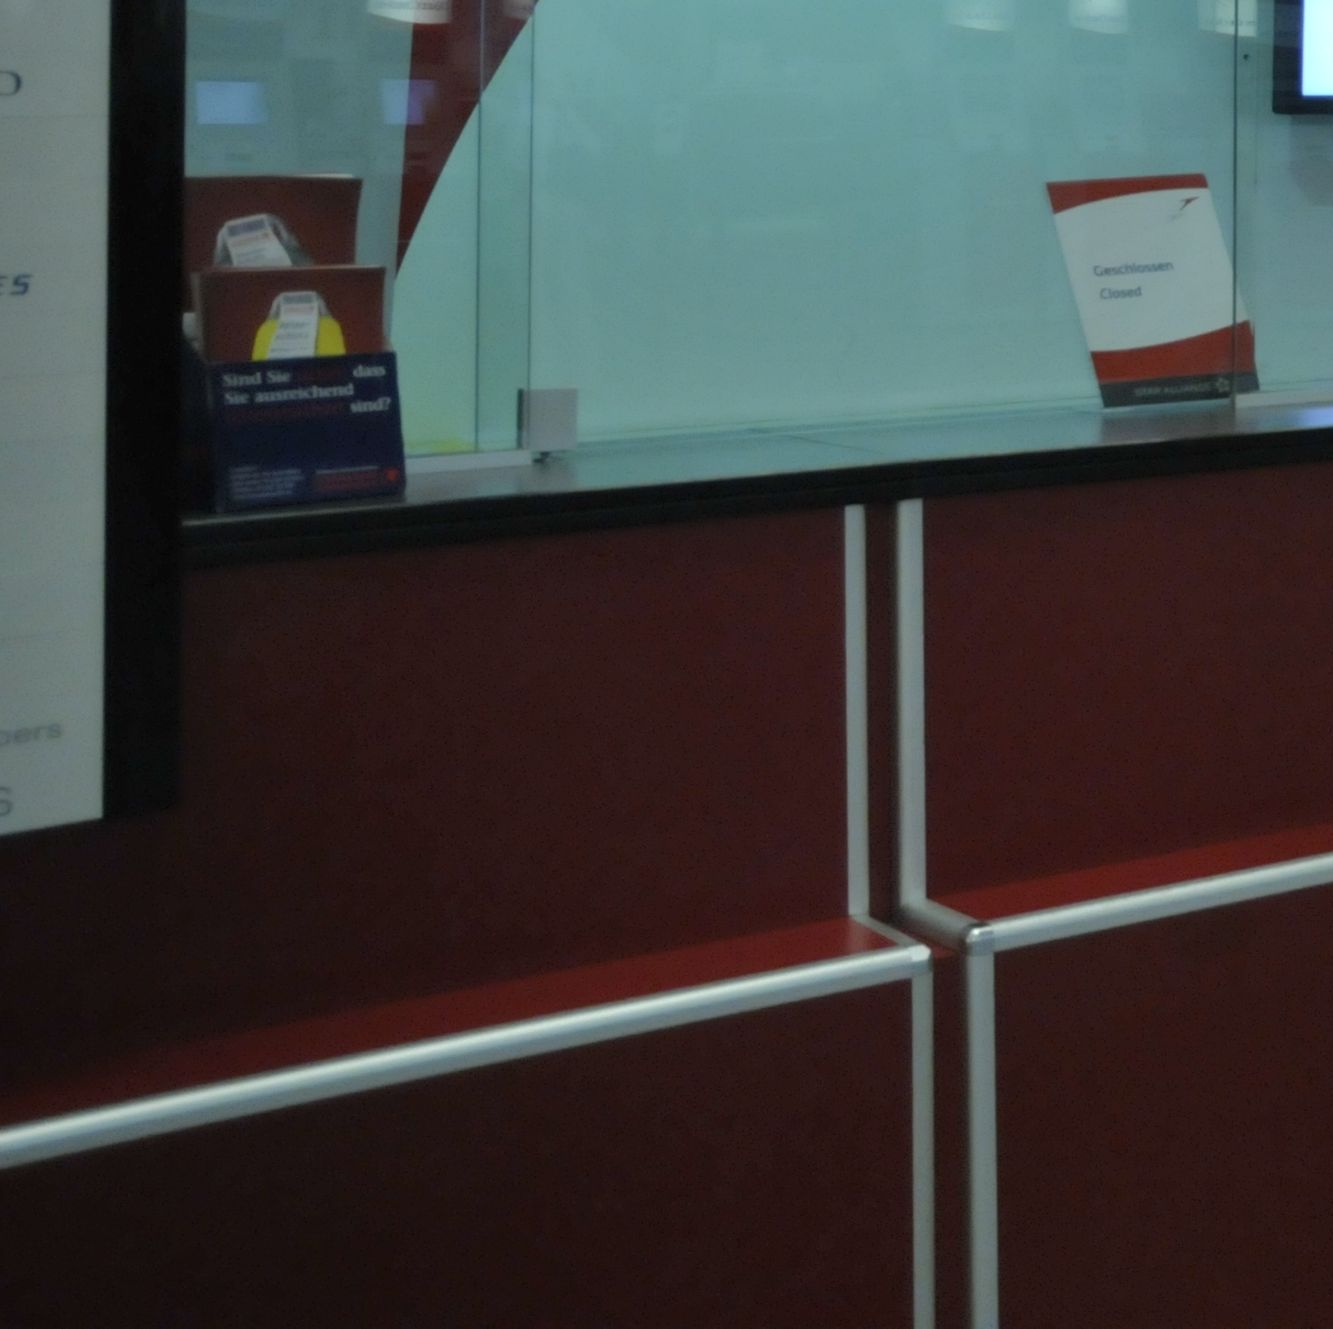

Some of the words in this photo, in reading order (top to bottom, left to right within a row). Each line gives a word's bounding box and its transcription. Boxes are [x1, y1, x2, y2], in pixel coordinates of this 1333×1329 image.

[1092, 260, 1175, 278] Geschlossen
[1100, 285, 1143, 301] Closed
[221, 372, 263, 389] Sind
[266, 370, 292, 385] Sie
[352, 362, 387, 379] dass
[223, 390, 250, 406] Sie
[253, 383, 355, 404] ausreichend
[350, 396, 391, 414] sind?
